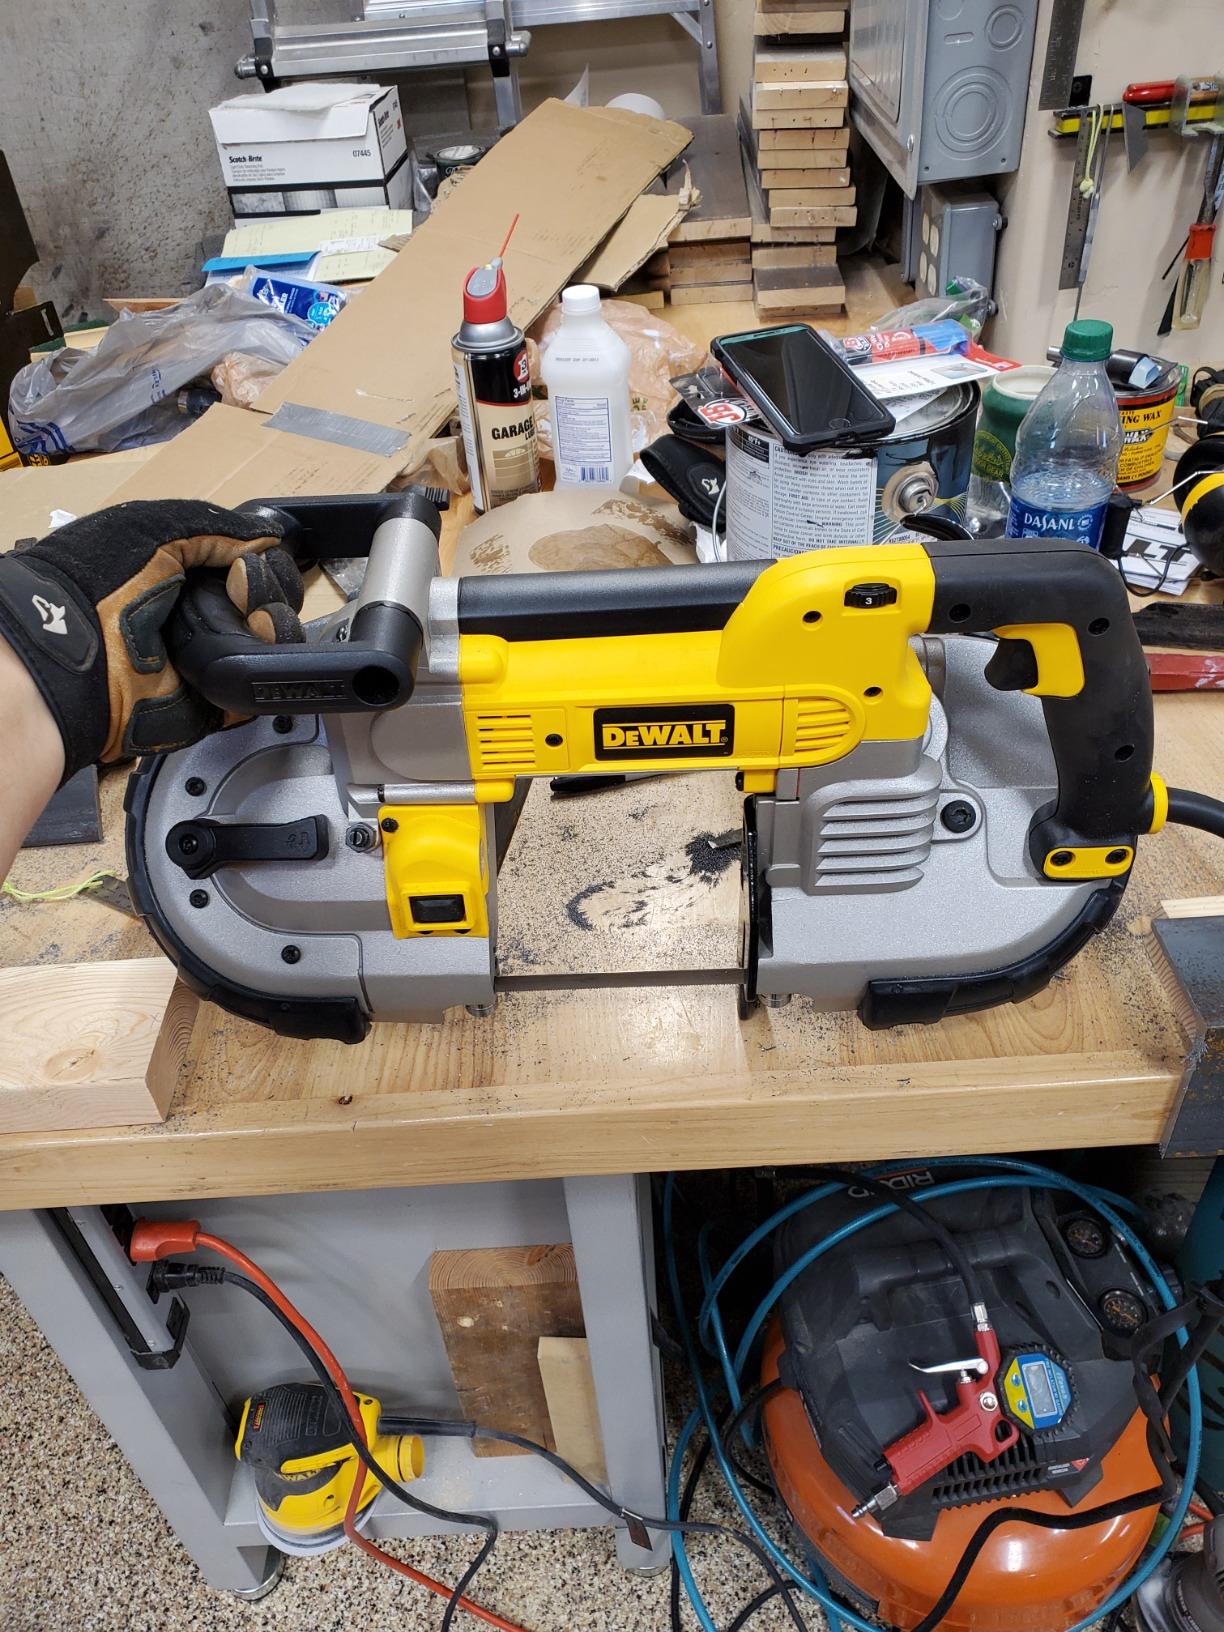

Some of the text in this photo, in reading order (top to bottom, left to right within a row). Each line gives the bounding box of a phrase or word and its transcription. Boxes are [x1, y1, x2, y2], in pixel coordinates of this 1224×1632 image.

[352, 149, 371, 158] 07445
[1143, 410, 1162, 421] WAX
[491, 416, 533, 440] GARAGE
[1024, 512, 1075, 532] DASANI
[864, 596, 873, 605] 3
[847, 1170, 936, 1199] RIDD
